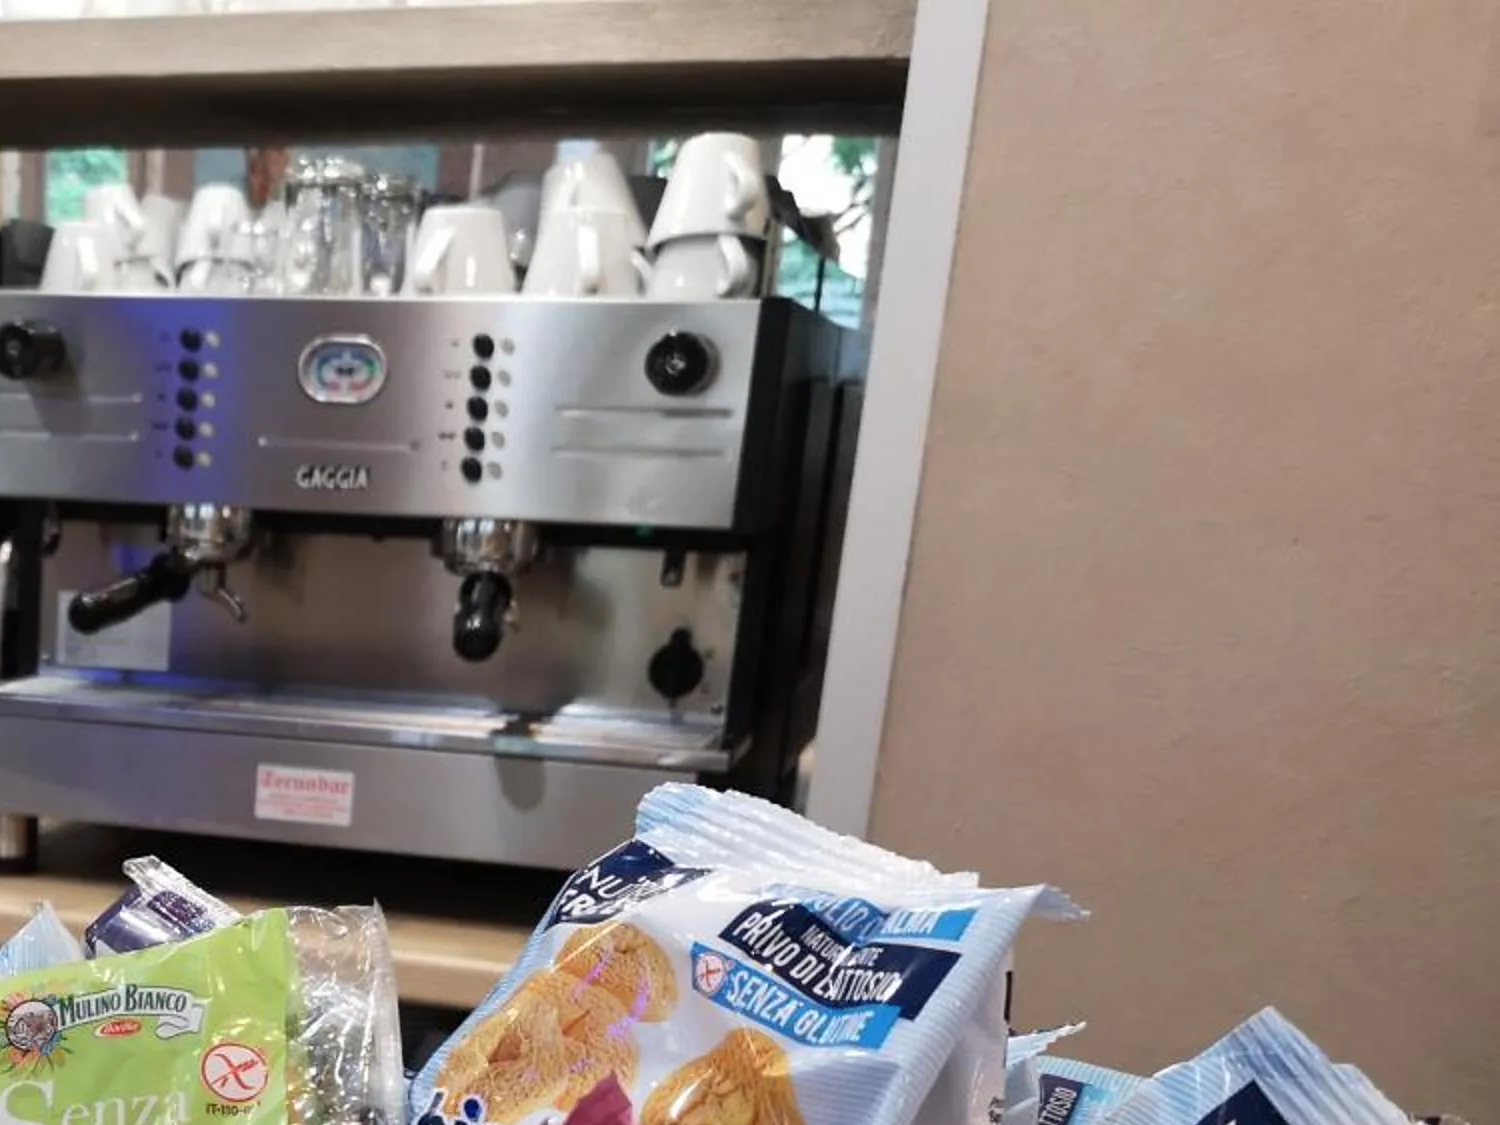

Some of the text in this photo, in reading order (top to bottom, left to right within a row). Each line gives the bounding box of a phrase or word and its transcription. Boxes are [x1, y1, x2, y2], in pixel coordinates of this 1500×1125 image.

[296, 464, 370, 488] GAGGIA
[733, 911, 792, 965] PRIVO
[791, 955, 817, 985] DI
[59, 983, 187, 1026] MULINO BIANCO
[726, 970, 795, 1027] SENZA
